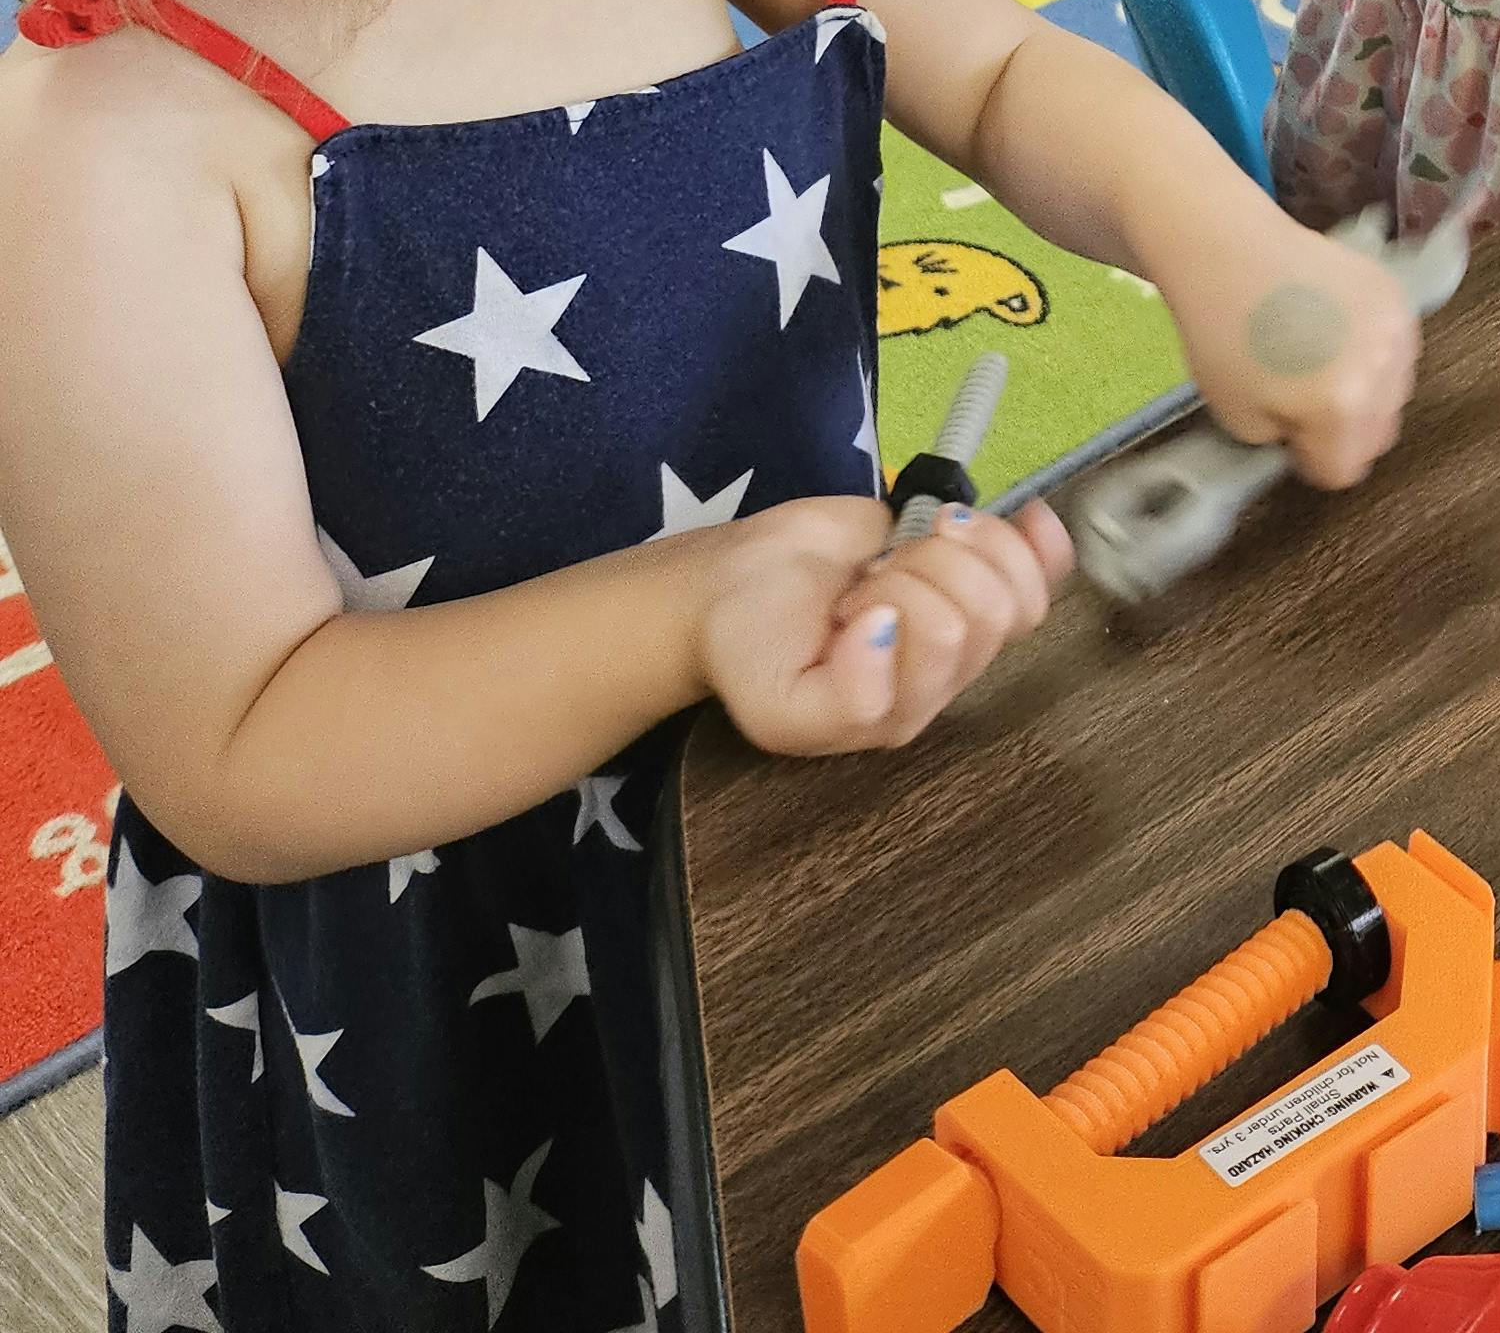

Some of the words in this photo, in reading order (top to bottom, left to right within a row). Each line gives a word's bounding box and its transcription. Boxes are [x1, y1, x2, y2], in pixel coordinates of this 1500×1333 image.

[1335, 1064, 1356, 1080] for
[1355, 1049, 1381, 1070] Not
[1286, 1076, 1336, 1111] children
[1304, 1088, 1342, 1115] Small
[1326, 1080, 1380, 1118] WARNING:
[1247, 1107, 1284, 1134] under
[1267, 1111, 1305, 1136] Parts
[1273, 1114, 1326, 1150] CHOKING
[1206, 1137, 1235, 1156] yrs.
[1234, 1130, 1248, 1142] 3
[1227, 1145, 1276, 1178] HAZARD
